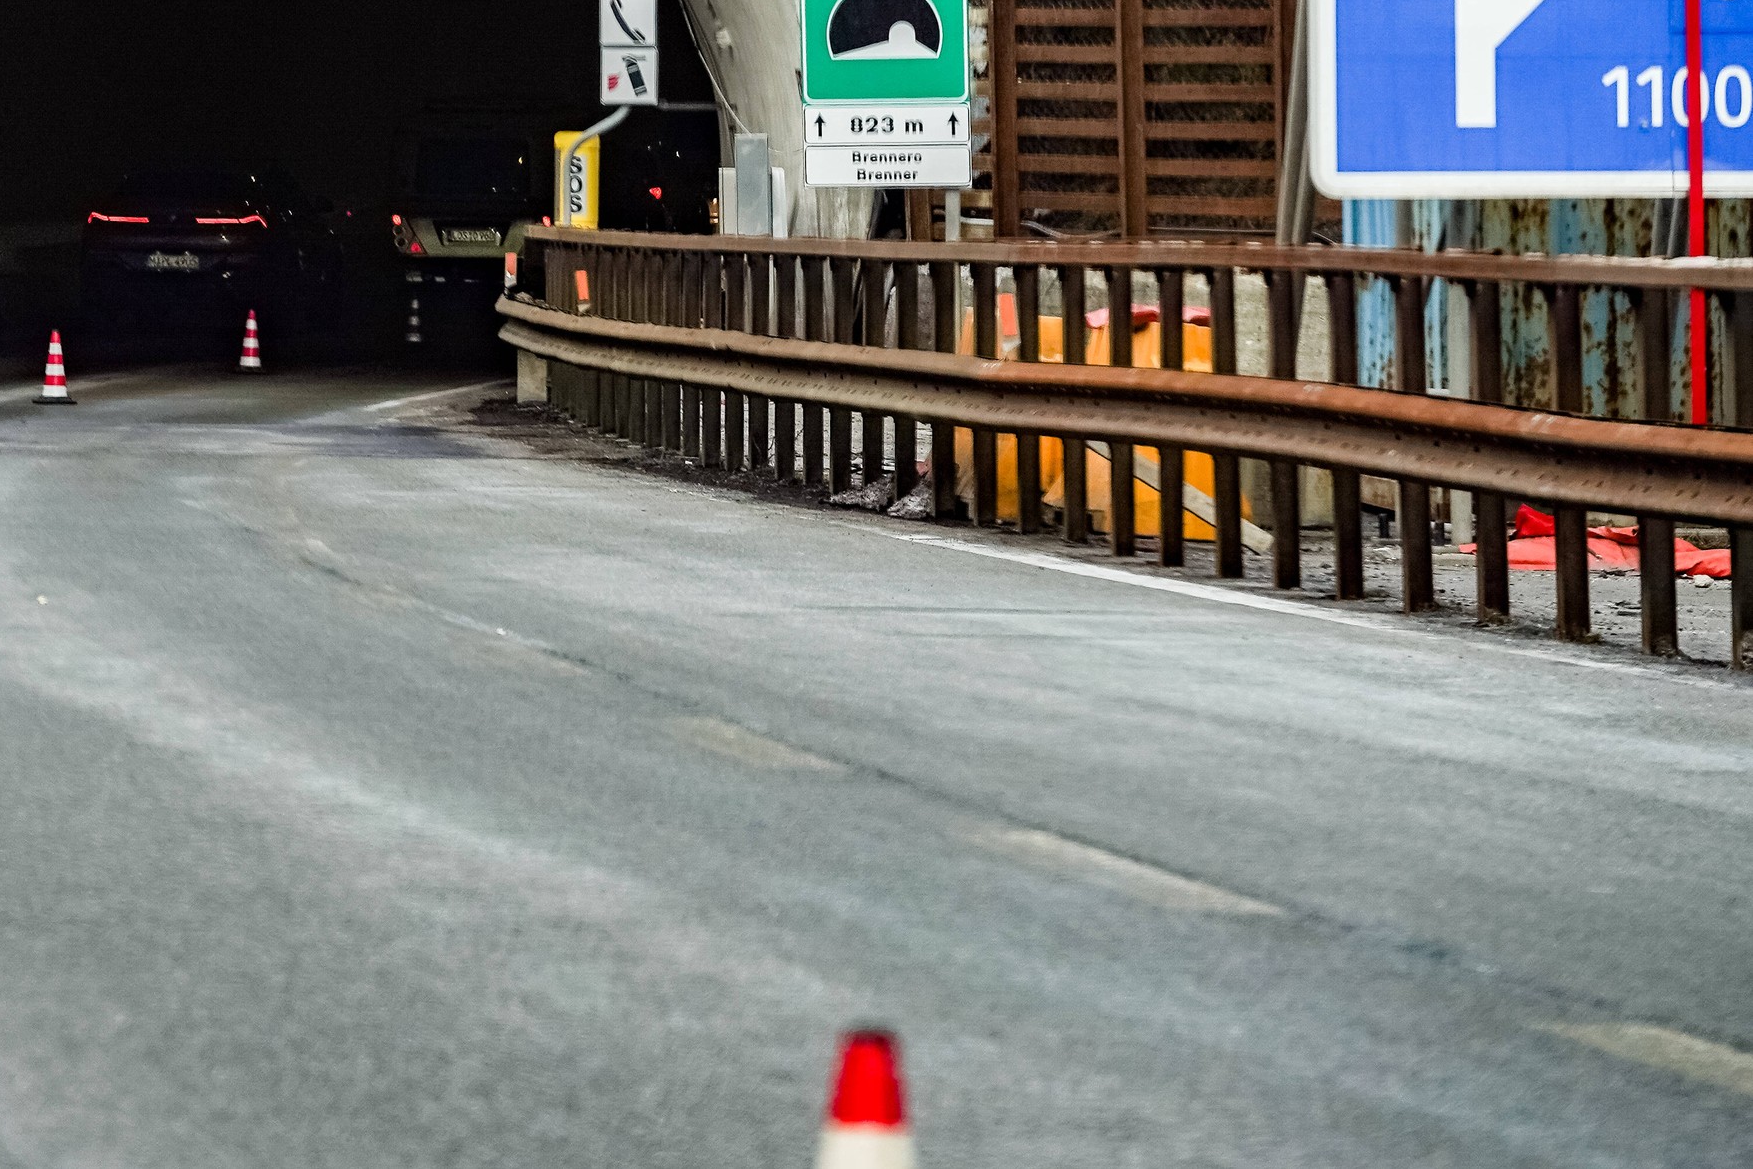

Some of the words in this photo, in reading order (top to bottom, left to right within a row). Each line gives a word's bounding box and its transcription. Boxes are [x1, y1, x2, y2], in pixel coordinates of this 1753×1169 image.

[1601, 64, 1753, 128] 1100
[850, 115, 895, 135] 823
[905, 118, 924, 135] m
[852, 151, 923, 164] Brennero
[569, 155, 583, 213] SOS
[856, 168, 919, 181] Brenner
